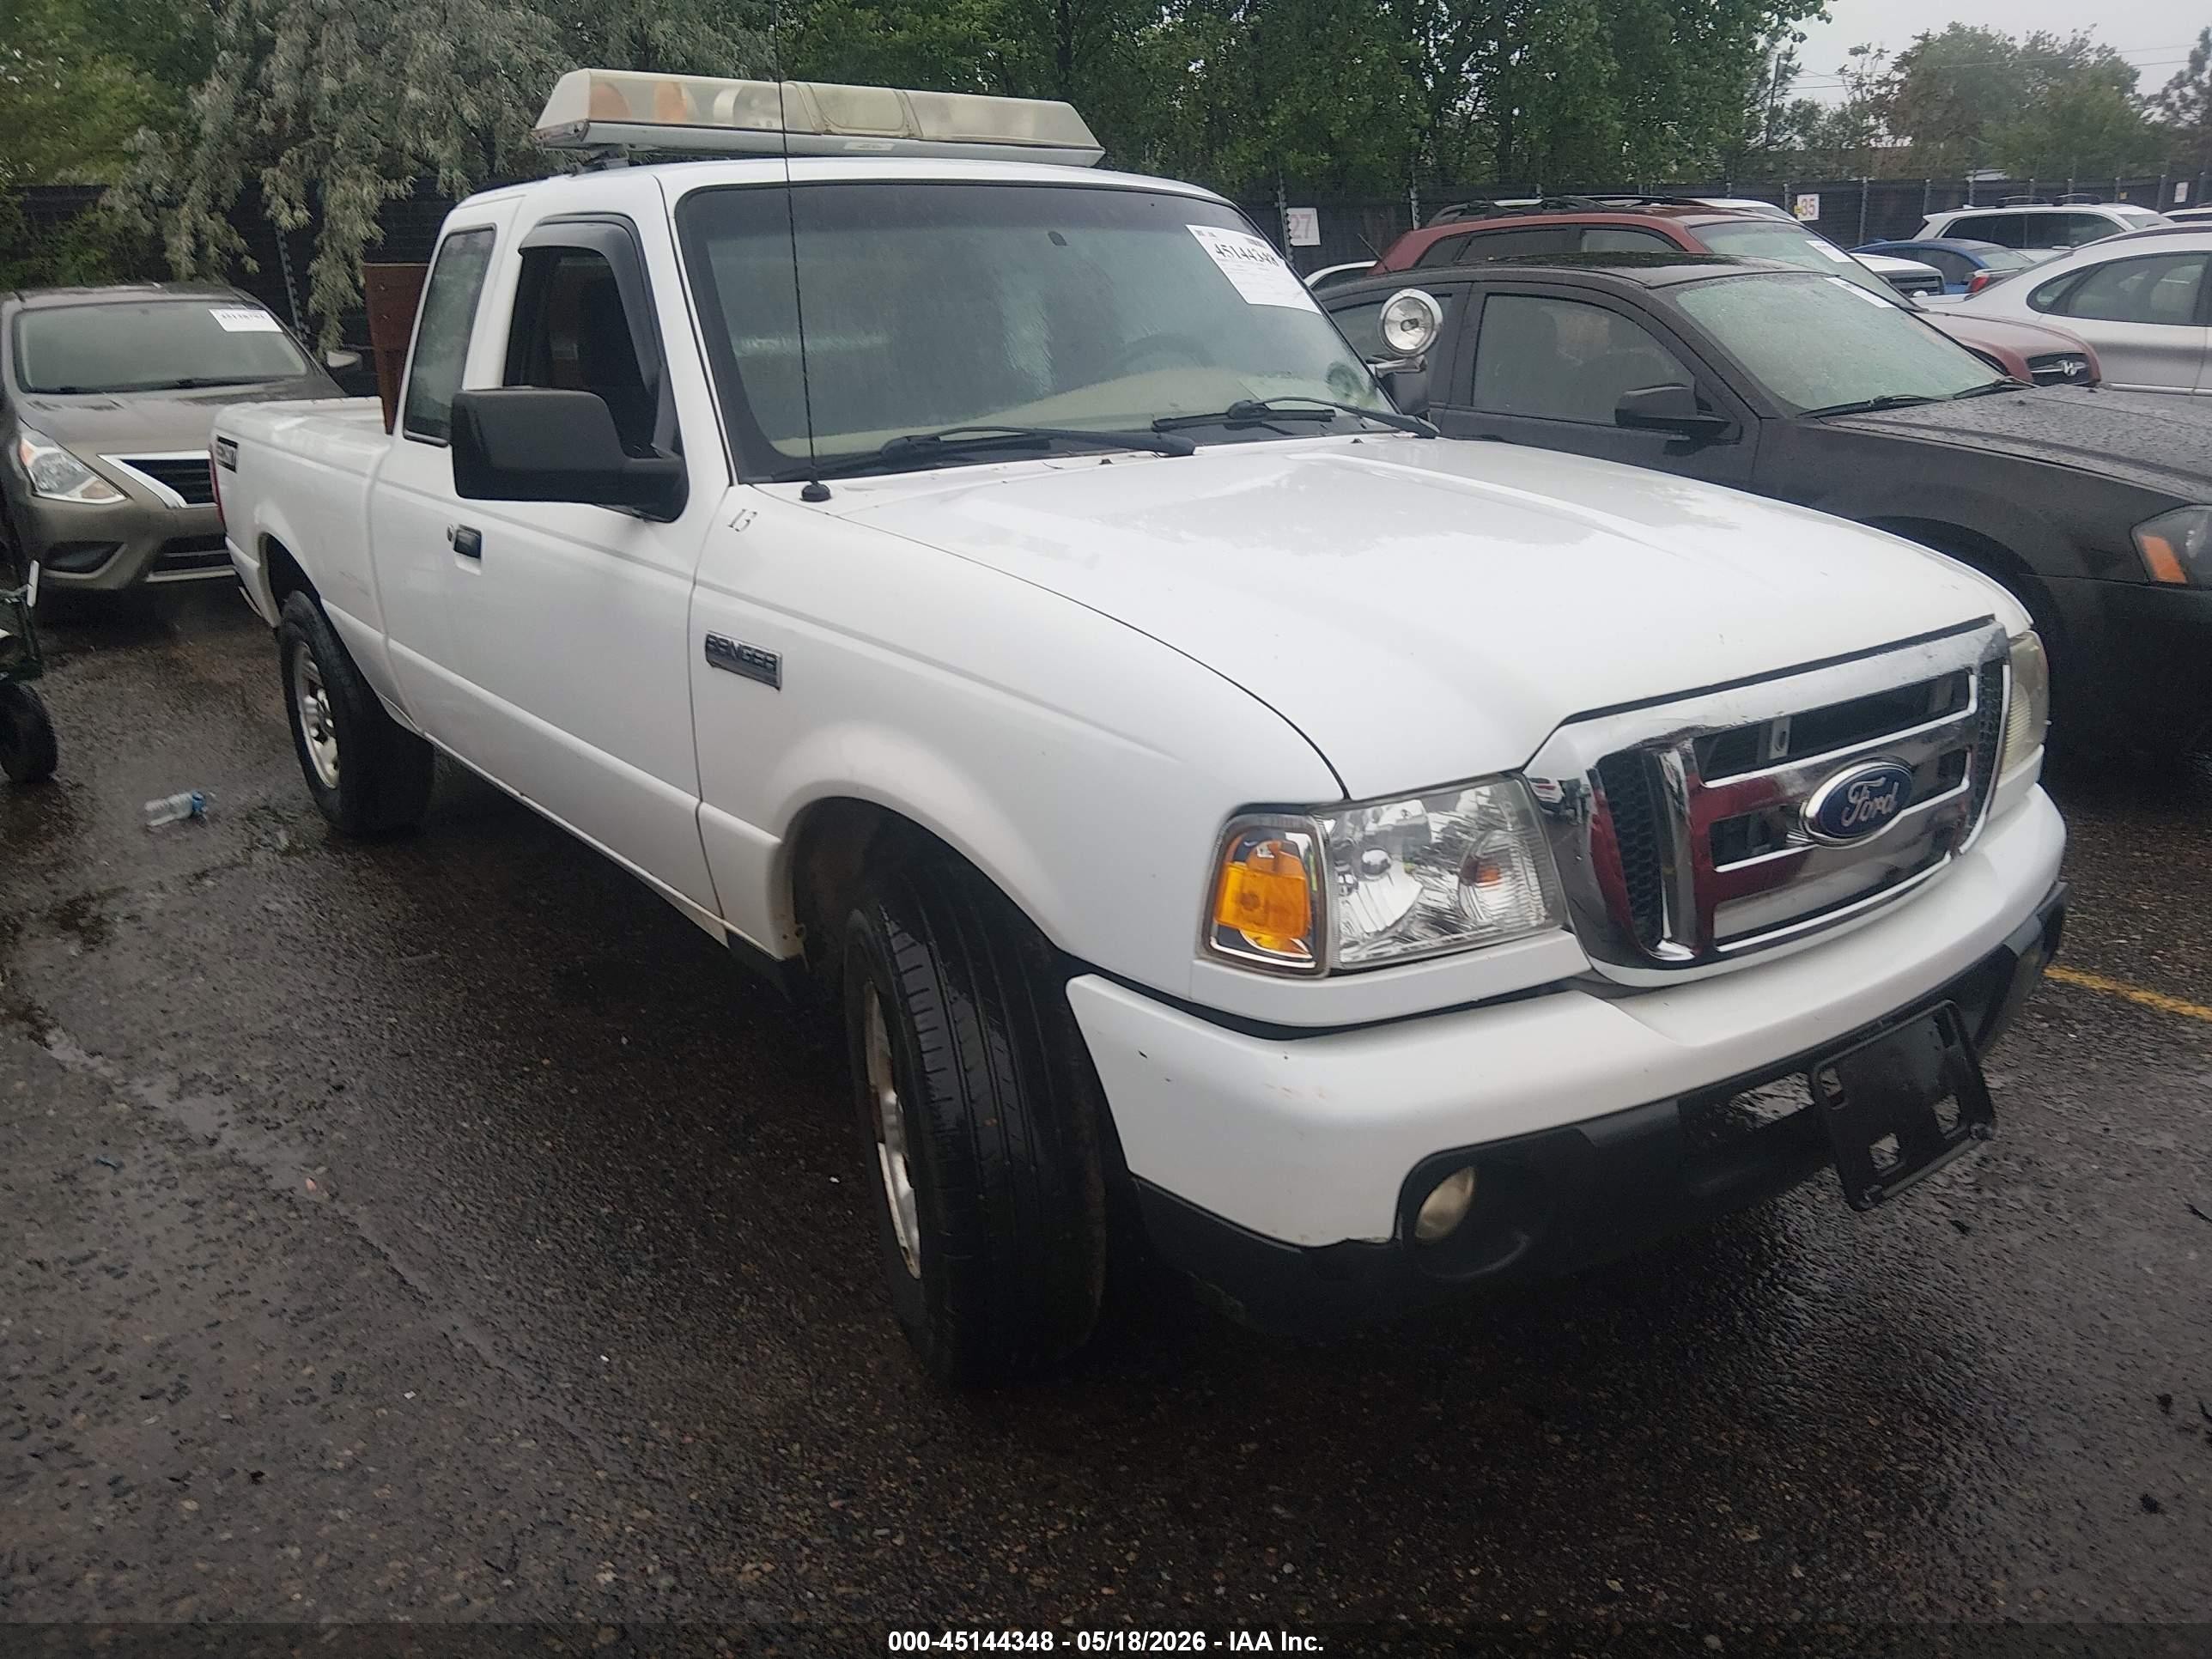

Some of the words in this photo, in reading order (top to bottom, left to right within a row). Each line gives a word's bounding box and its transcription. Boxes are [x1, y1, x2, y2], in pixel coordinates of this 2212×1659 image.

[1291, 213, 1312, 240] 27
[706, 635, 777, 671] RANGER
[1840, 775, 1901, 828] Ford
